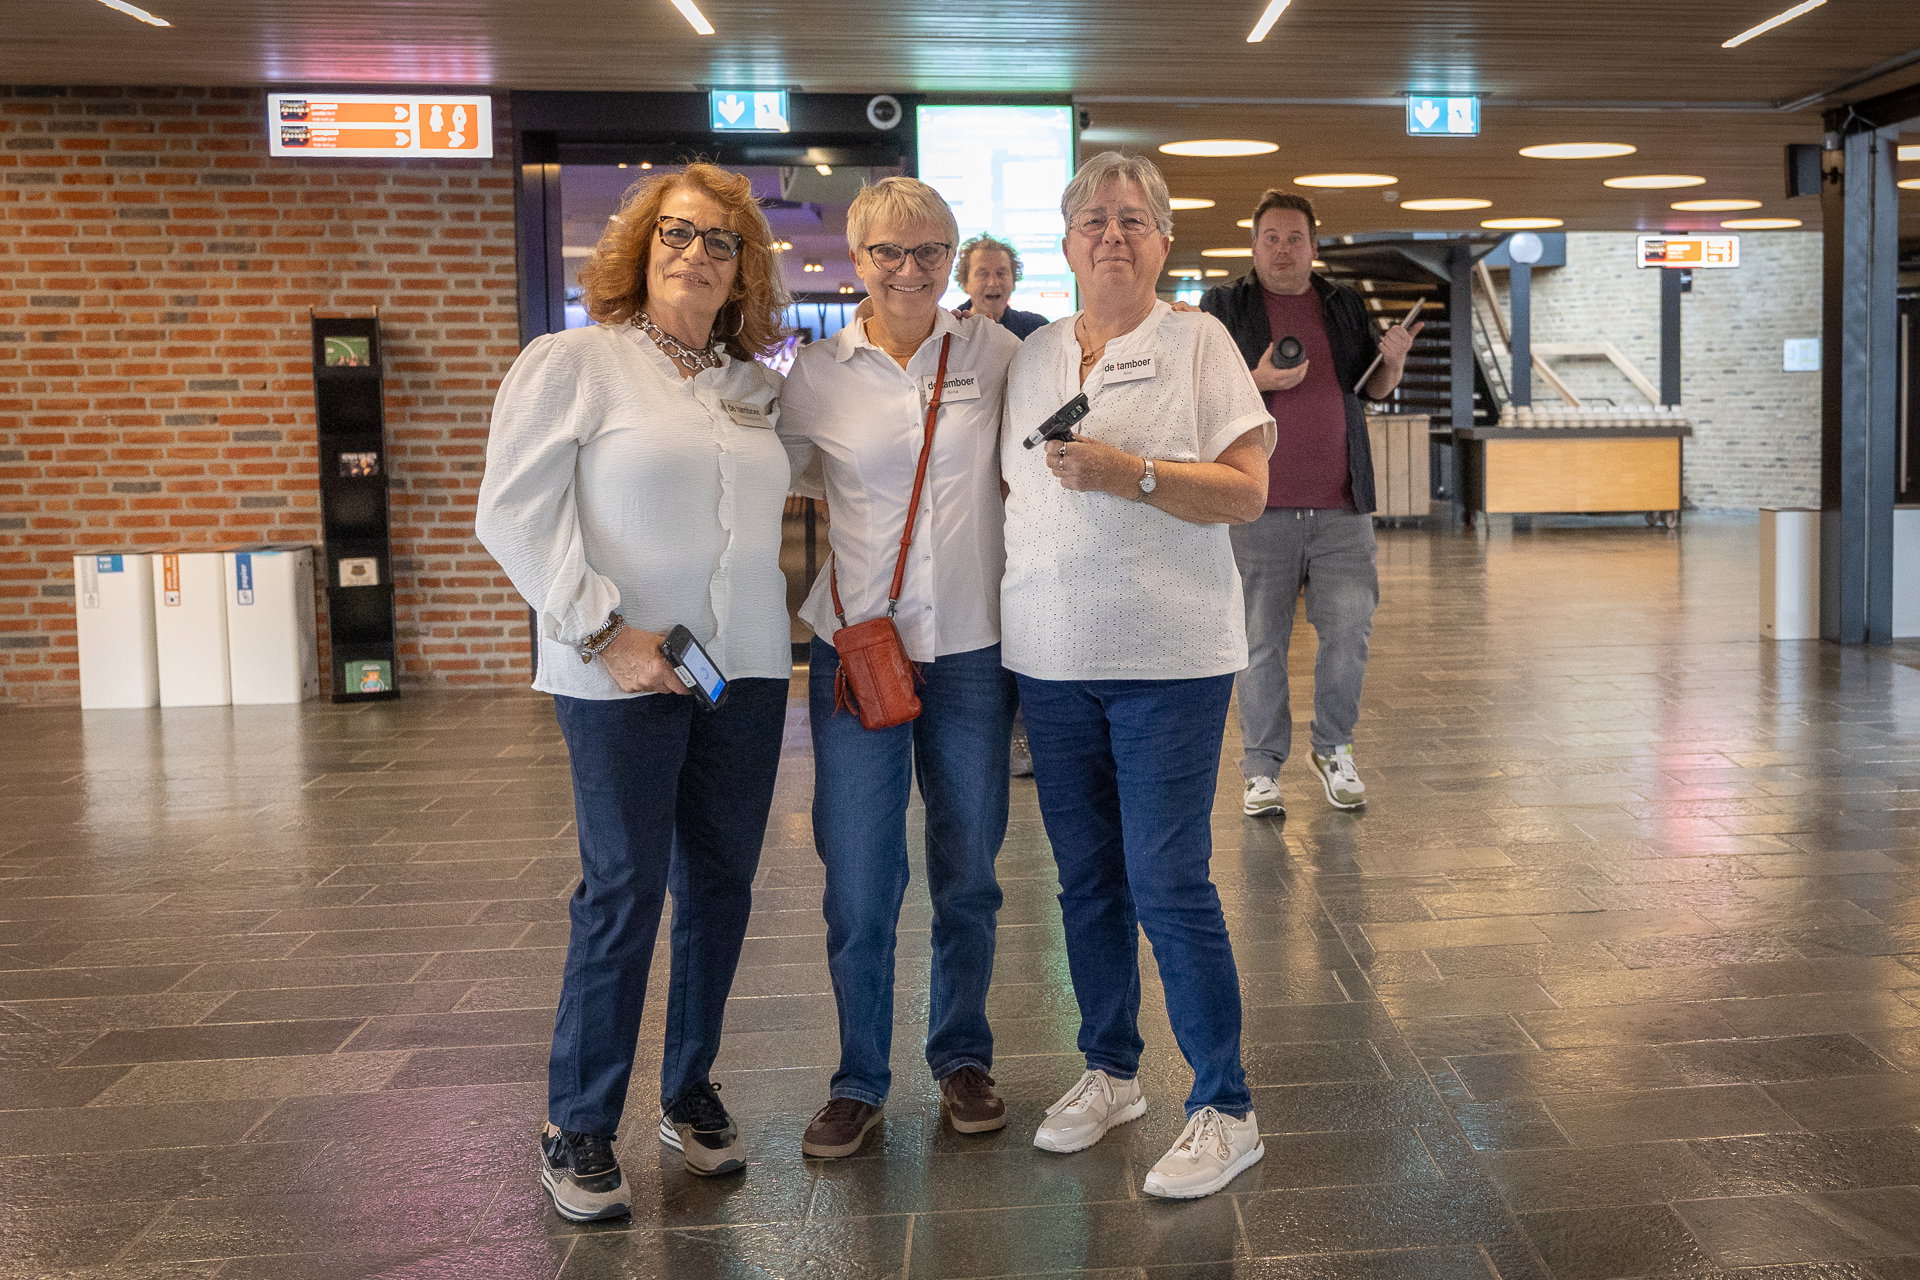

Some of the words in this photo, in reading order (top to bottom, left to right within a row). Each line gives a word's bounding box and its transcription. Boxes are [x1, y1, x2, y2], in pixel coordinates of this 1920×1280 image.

[1104, 363, 1115, 372] de
[1116, 358, 1151, 370] tamboer
[927, 381, 936, 390] d
[943, 378, 975, 389] amboer
